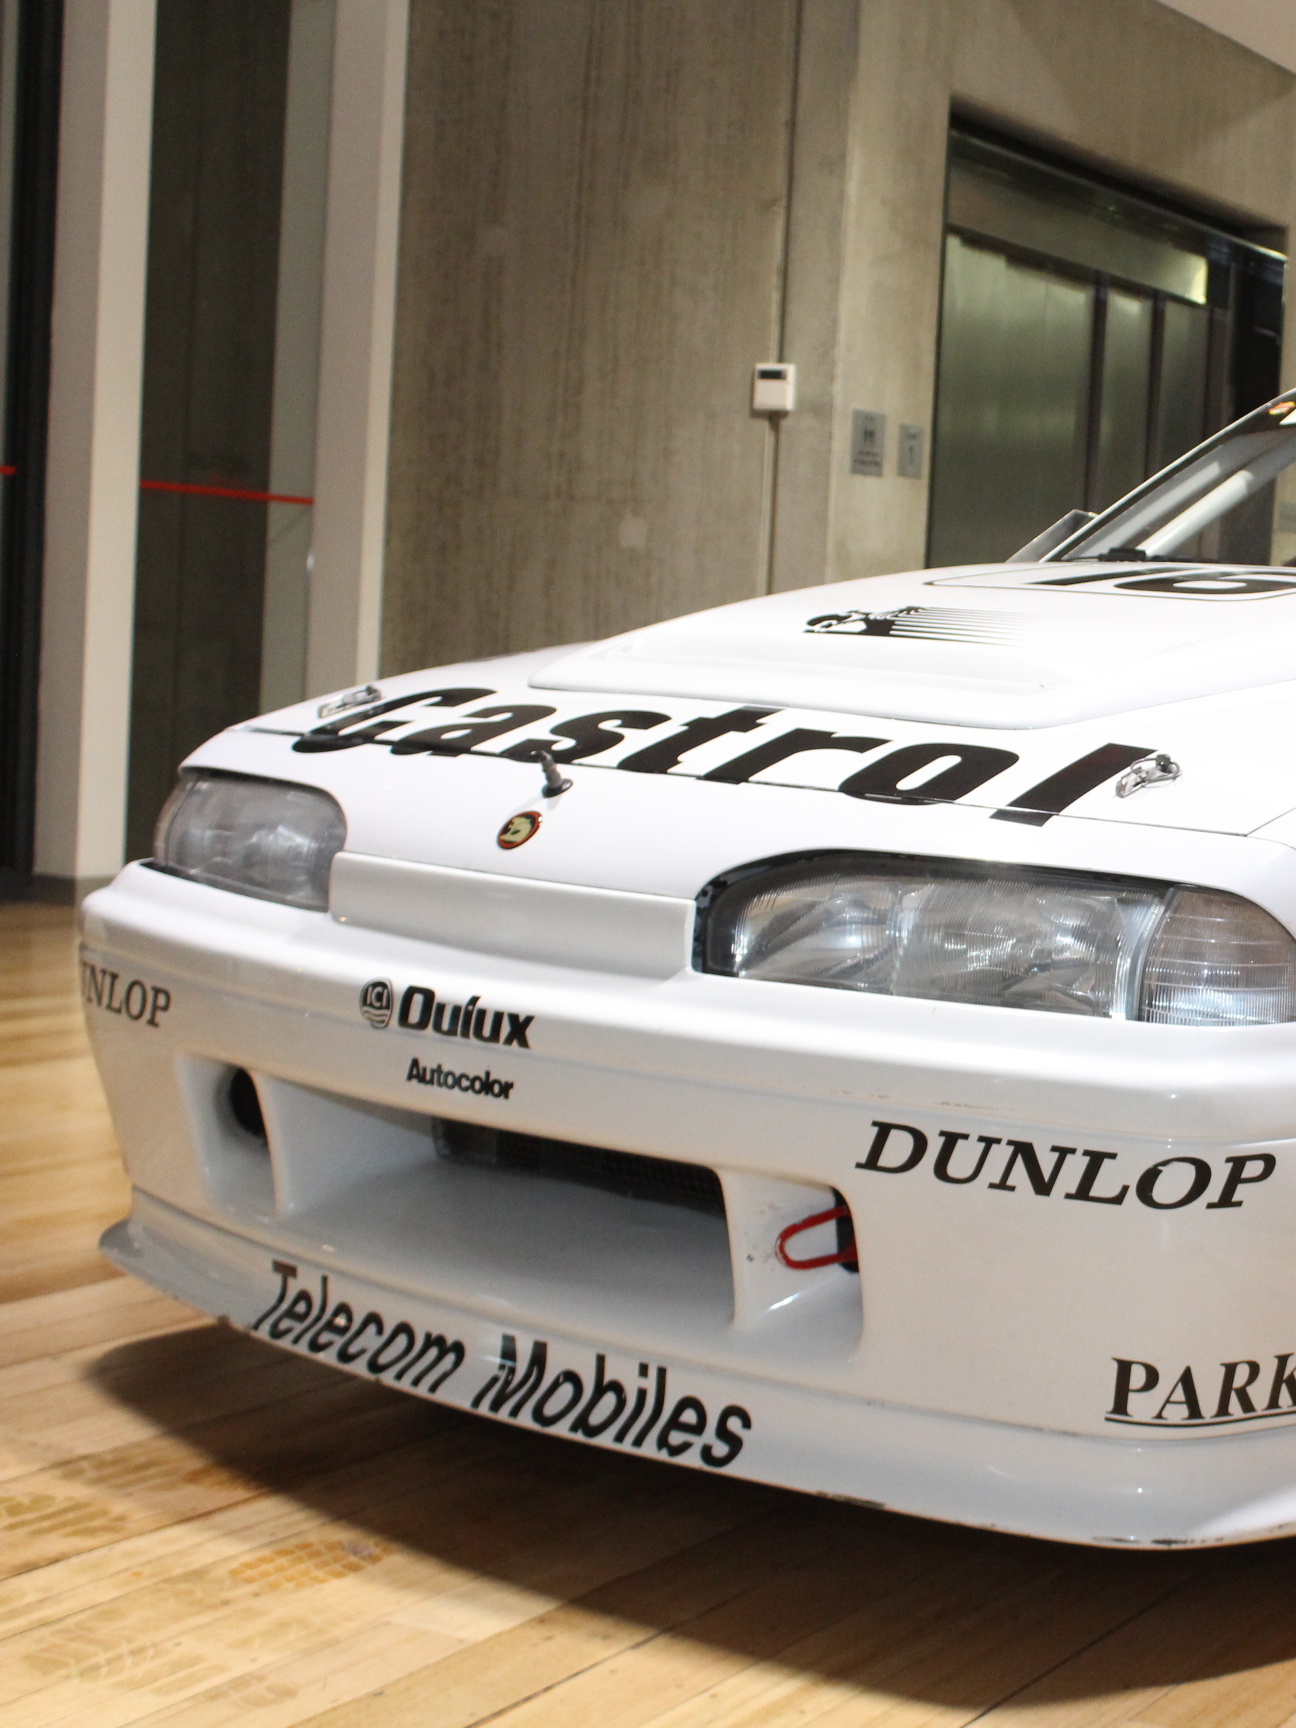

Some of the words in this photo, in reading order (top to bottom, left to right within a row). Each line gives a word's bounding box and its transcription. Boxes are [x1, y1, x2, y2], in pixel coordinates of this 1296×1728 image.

[292, 687, 1158, 826] Castrol
[82, 962, 171, 1028] NLOP
[366, 986, 388, 1008] ICI
[406, 1057, 515, 1100] Autocolor
[854, 1120, 1277, 1210] DUNLOP
[251, 1260, 466, 1394] Telecom
[471, 1334, 752, 1468] Mobiles
